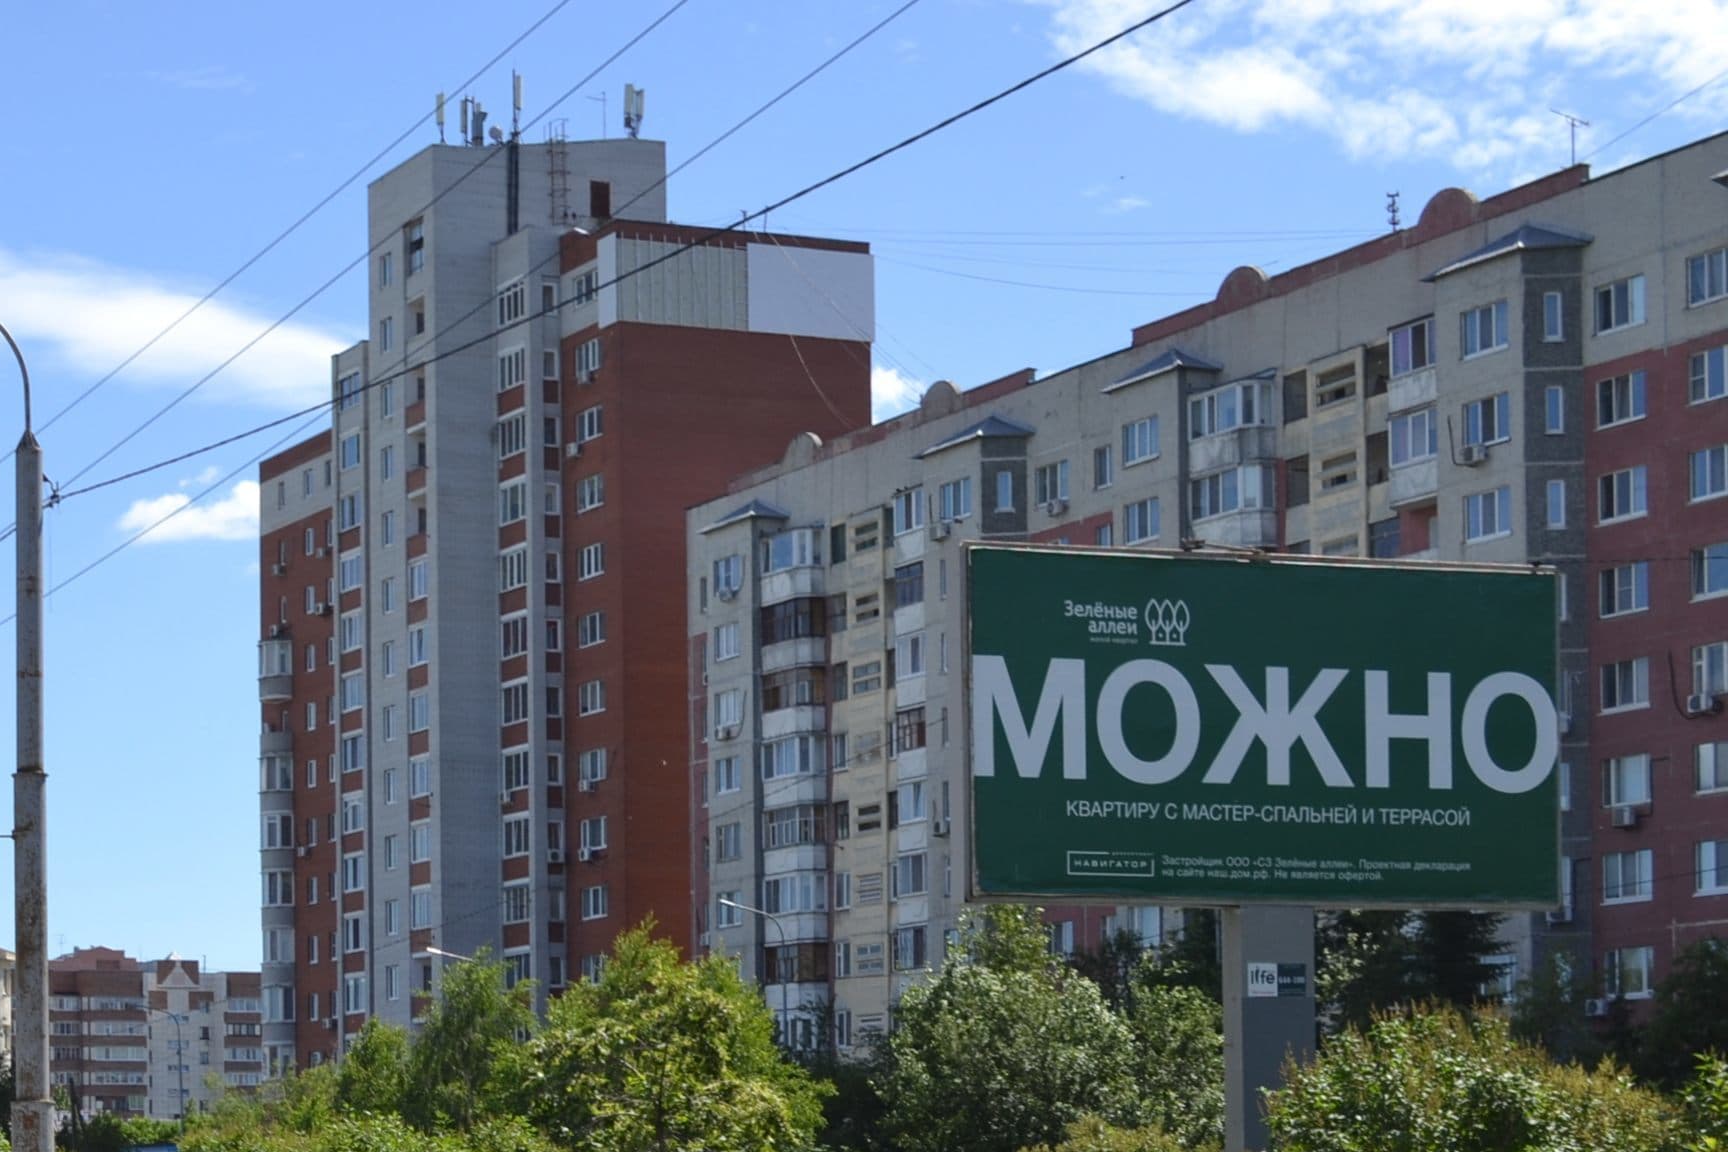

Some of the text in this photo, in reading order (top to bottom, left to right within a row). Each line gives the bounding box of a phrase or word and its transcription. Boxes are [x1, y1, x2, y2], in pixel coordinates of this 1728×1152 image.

[1064, 600, 1138, 619] Зелёные
[1088, 620, 1138, 634] аллеи
[972, 654, 1558, 794] МОЖНО
[1067, 800, 1471, 826] КВАРТИРУ С МАСТЕР-СПАЛЬНЕЙ И ТЕРРАСОЙ
[1074, 859, 1148, 868] НАВИГАТОР
[1226, 856, 1250, 867] ООО
[1359, 859, 1411, 871] Проектная
[1414, 861, 1471, 872] декларация
[1176, 867, 1205, 878] сайте
[1274, 870, 1288, 879] Не
[1290, 872, 1336, 881] является
